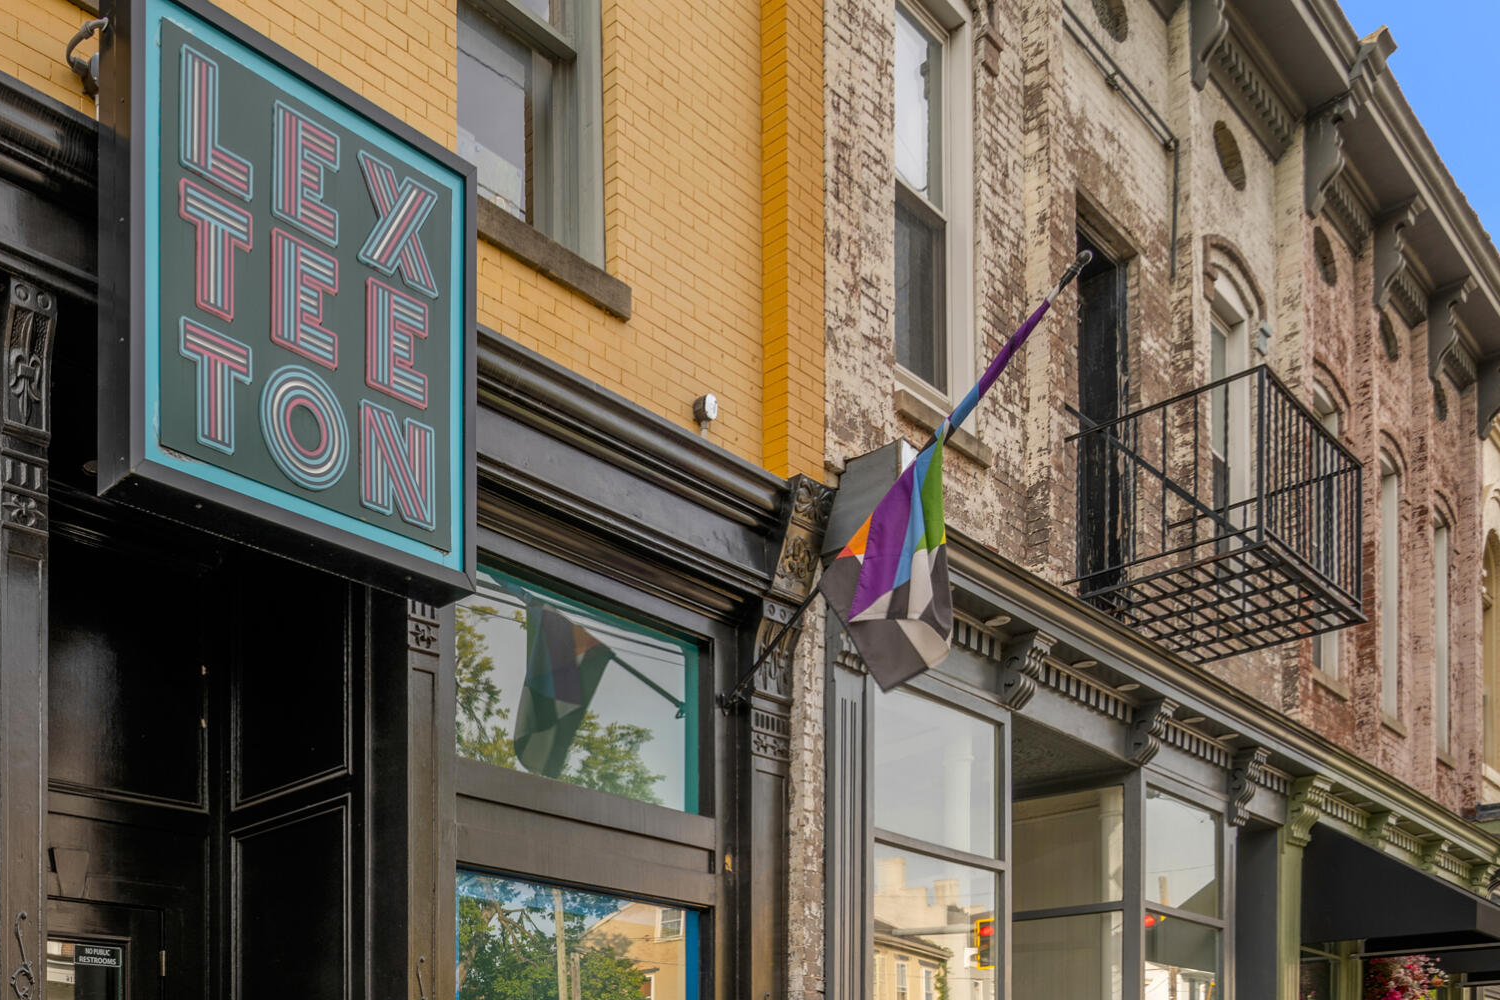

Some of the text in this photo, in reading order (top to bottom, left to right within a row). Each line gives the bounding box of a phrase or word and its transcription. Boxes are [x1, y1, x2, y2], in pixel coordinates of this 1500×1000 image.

[179, 43, 438, 299] LEX
[179, 177, 429, 410] TEE
[179, 315, 436, 532] TON
[79, 956, 116, 965] RESTROOMS
[93, 948, 111, 956] PUBLIC
